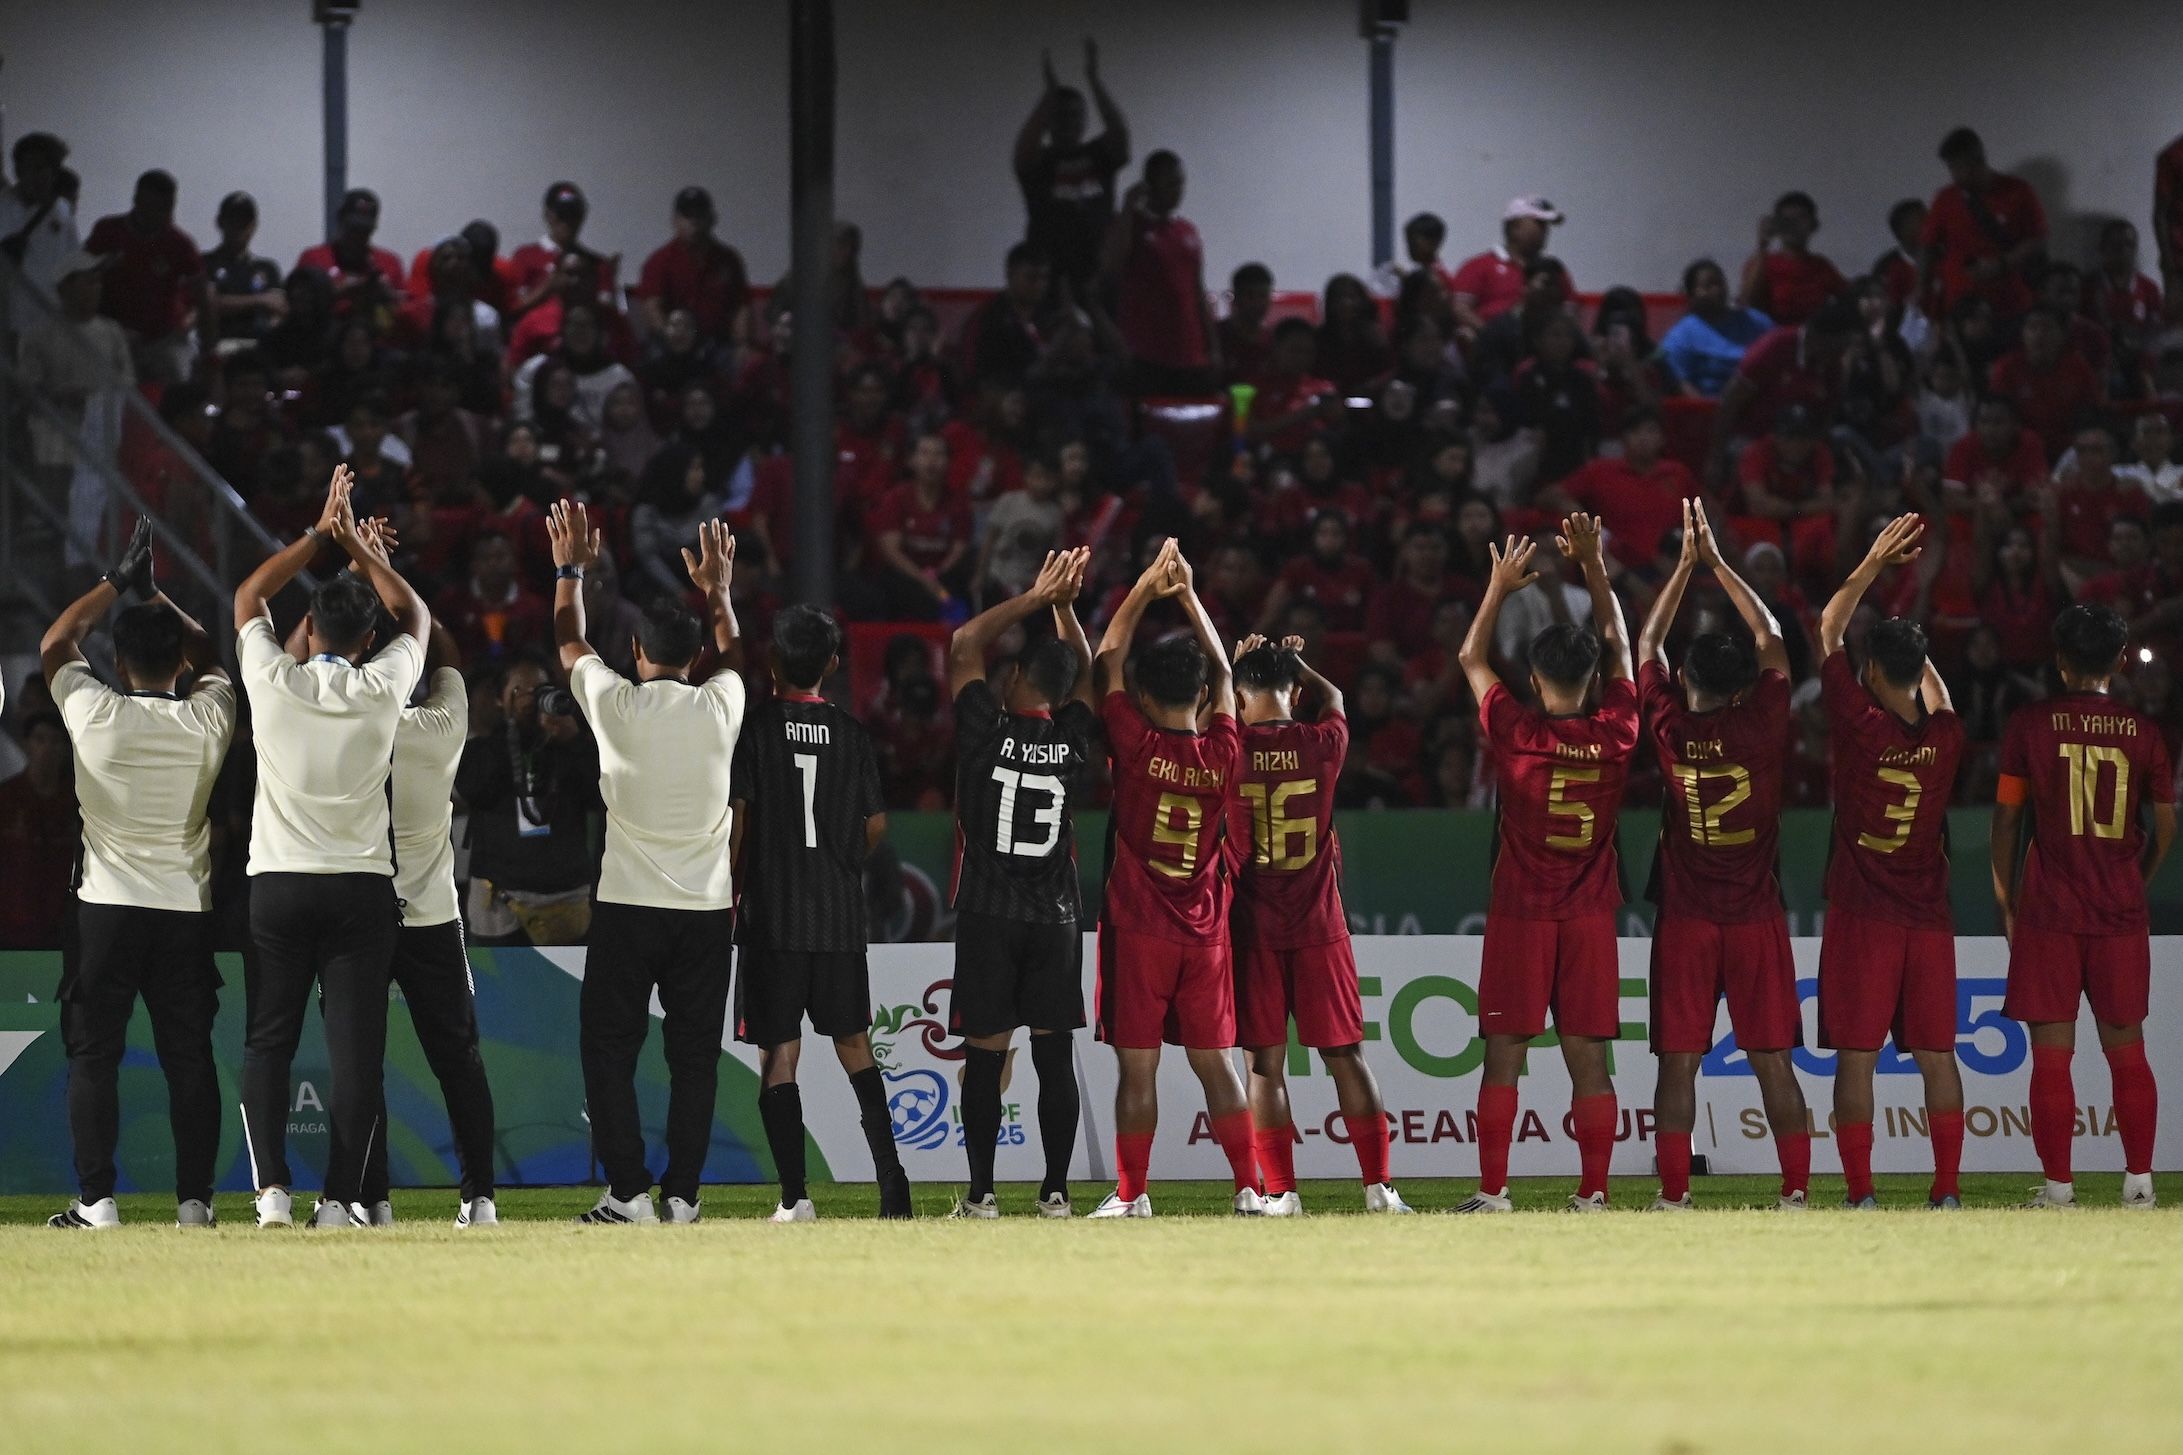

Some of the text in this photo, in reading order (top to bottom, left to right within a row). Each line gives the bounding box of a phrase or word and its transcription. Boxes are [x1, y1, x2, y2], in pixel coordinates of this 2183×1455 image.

[785, 720, 831, 745] AMIN
[1000, 737, 1070, 764] A. YUSUP
[1253, 750, 1300, 772] RIZKI
[2051, 713, 2137, 736] M. YAHYA
[793, 752, 818, 849] 1
[1147, 755, 1181, 783] EKO
[1545, 767, 1600, 849] 5
[1672, 763, 1756, 846] 12
[1857, 766, 1922, 854] 3
[2058, 742, 2130, 840] 10
[991, 765, 1066, 857] 13
[1148, 790, 1203, 879] 9
[1239, 778, 1318, 871] 16
[955, 1124, 1026, 1147] 225
